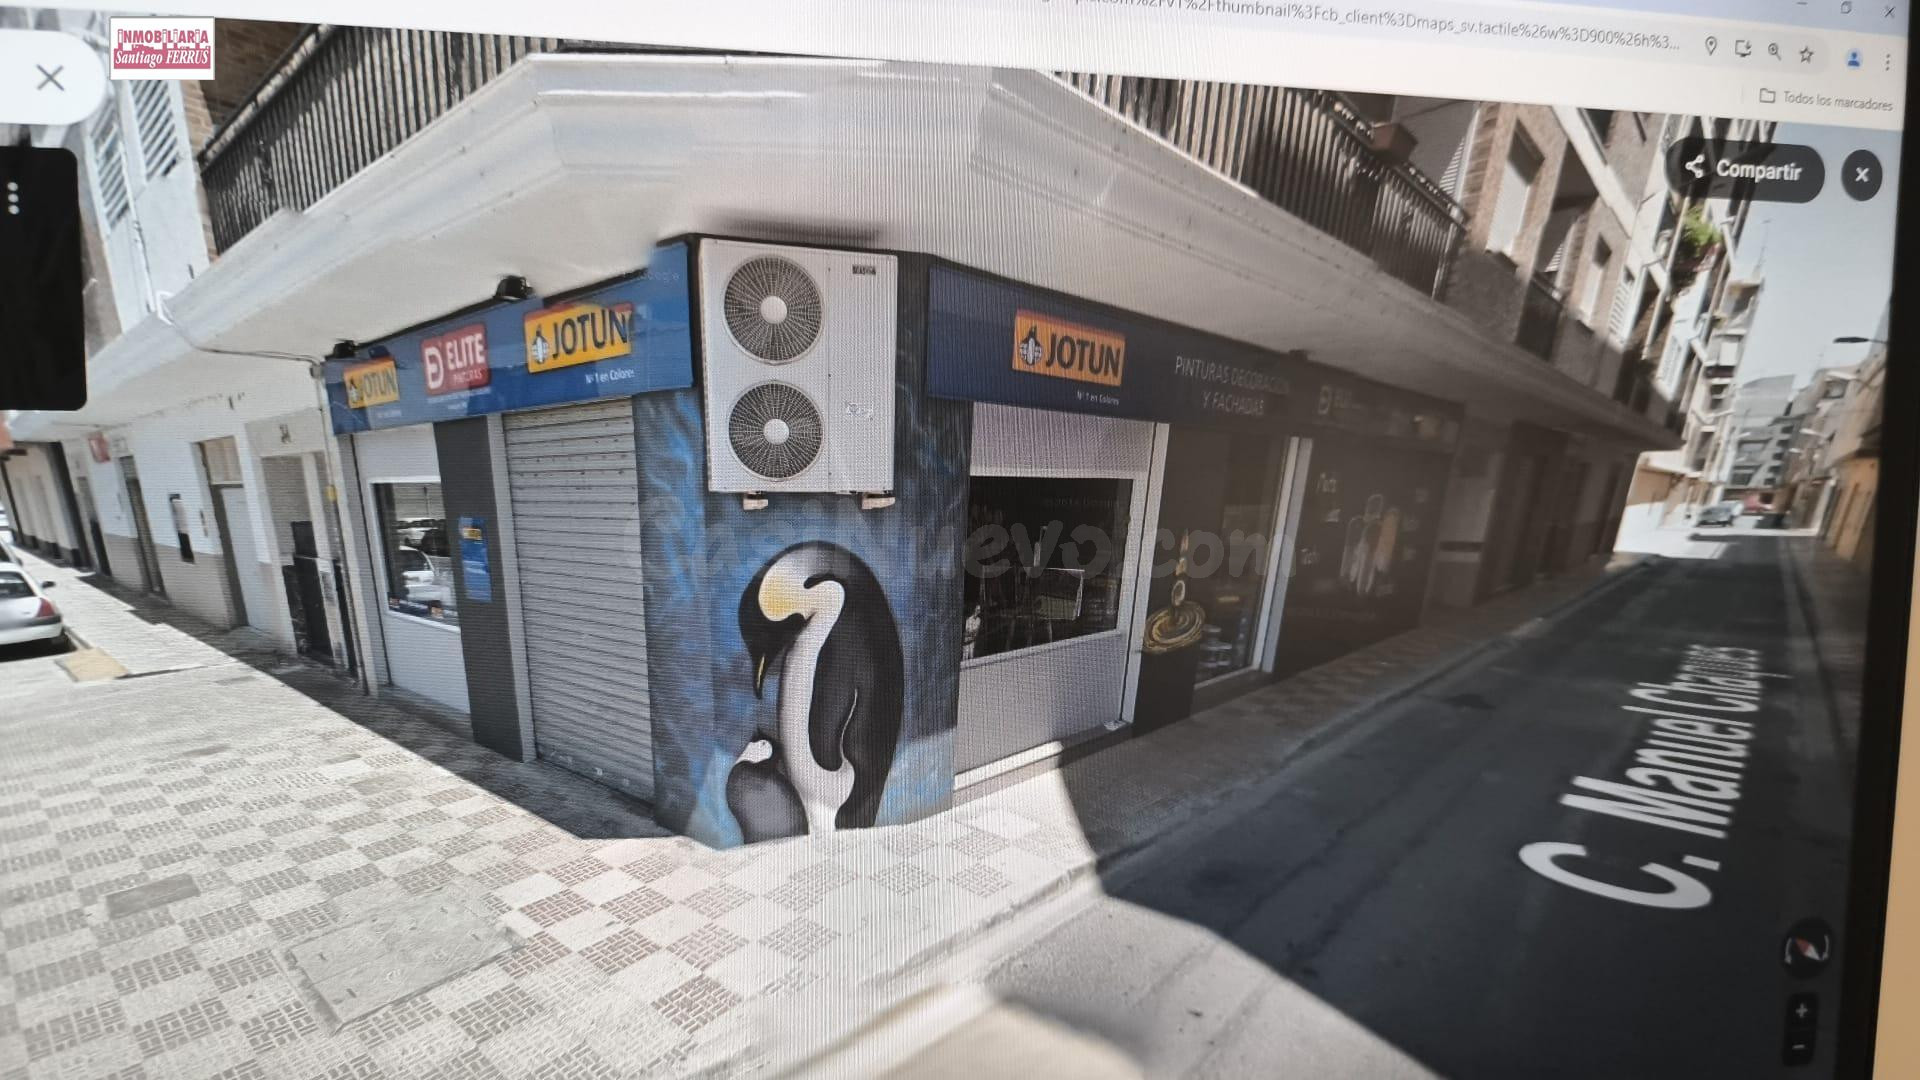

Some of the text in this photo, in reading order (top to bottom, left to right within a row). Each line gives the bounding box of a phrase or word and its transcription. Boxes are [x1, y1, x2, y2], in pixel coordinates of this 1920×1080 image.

[1783, 90, 1894, 112] Todos los marcadores
[1716, 158, 1802, 184] Compartir
[445, 332, 486, 371] ELITE
[552, 307, 635, 360] JOTUN
[1045, 331, 1121, 379] JOTUN
[1174, 355, 1231, 384] PINTURAS
[1202, 391, 1265, 417] Y FACHADAS
[1558, 703, 1757, 840] Manuel
[1518, 841, 1721, 909] C.
